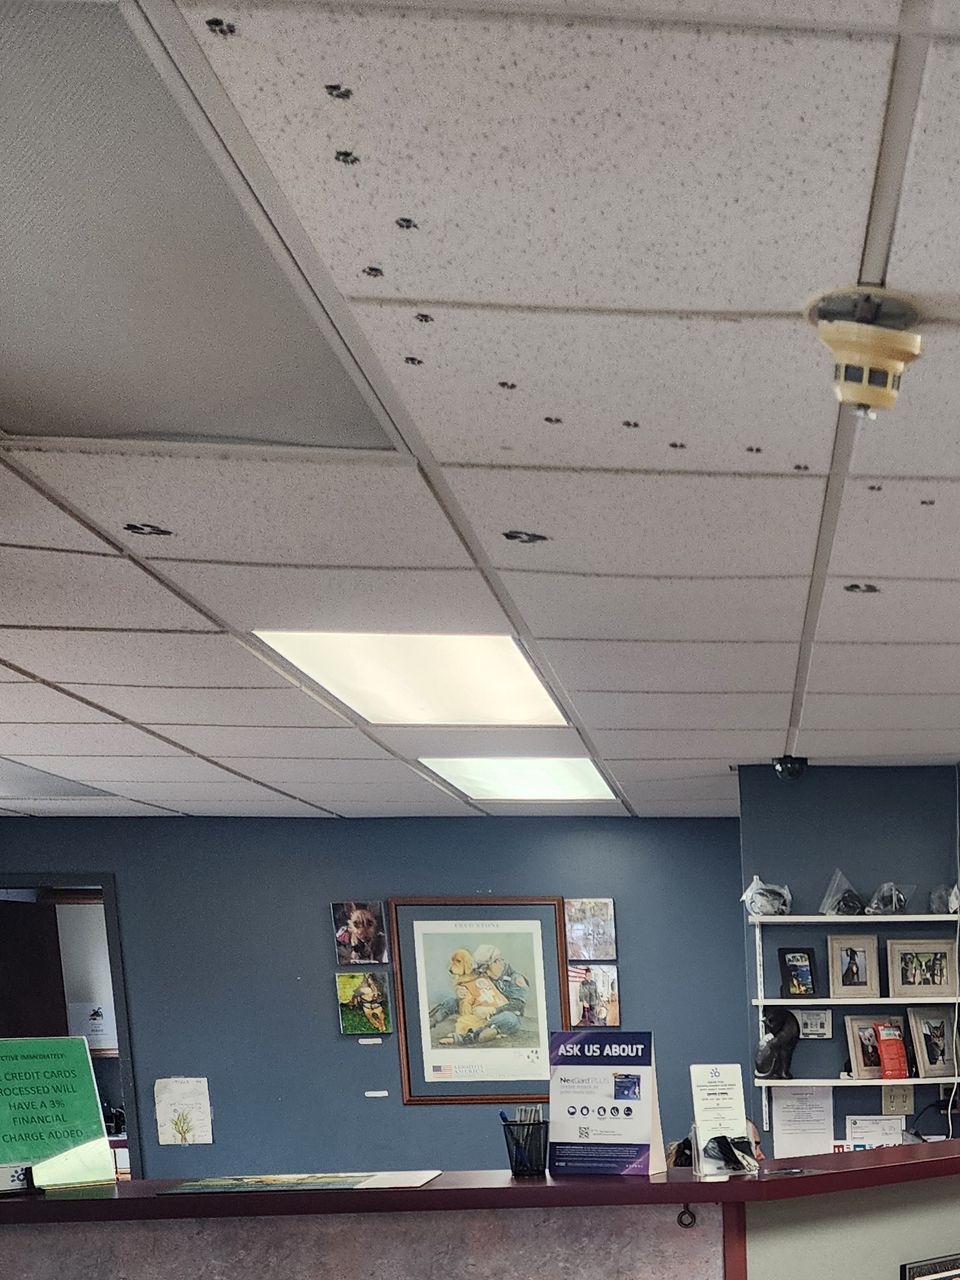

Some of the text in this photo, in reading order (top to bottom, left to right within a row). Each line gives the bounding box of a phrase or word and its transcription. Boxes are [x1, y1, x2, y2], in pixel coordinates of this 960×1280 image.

[558, 1044, 645, 1057] ASK US ABOUT
[4, 1071, 41, 1081] CREDIT
[43, 1069, 78, 1080] CARDS
[0, 1084, 78, 1097] ROCESSED WILL
[8, 1099, 65, 1111] HAVE A 3%
[12, 1113, 68, 1126] FINANCIAL
[2, 1129, 84, 1143] CHARGE ADDED
